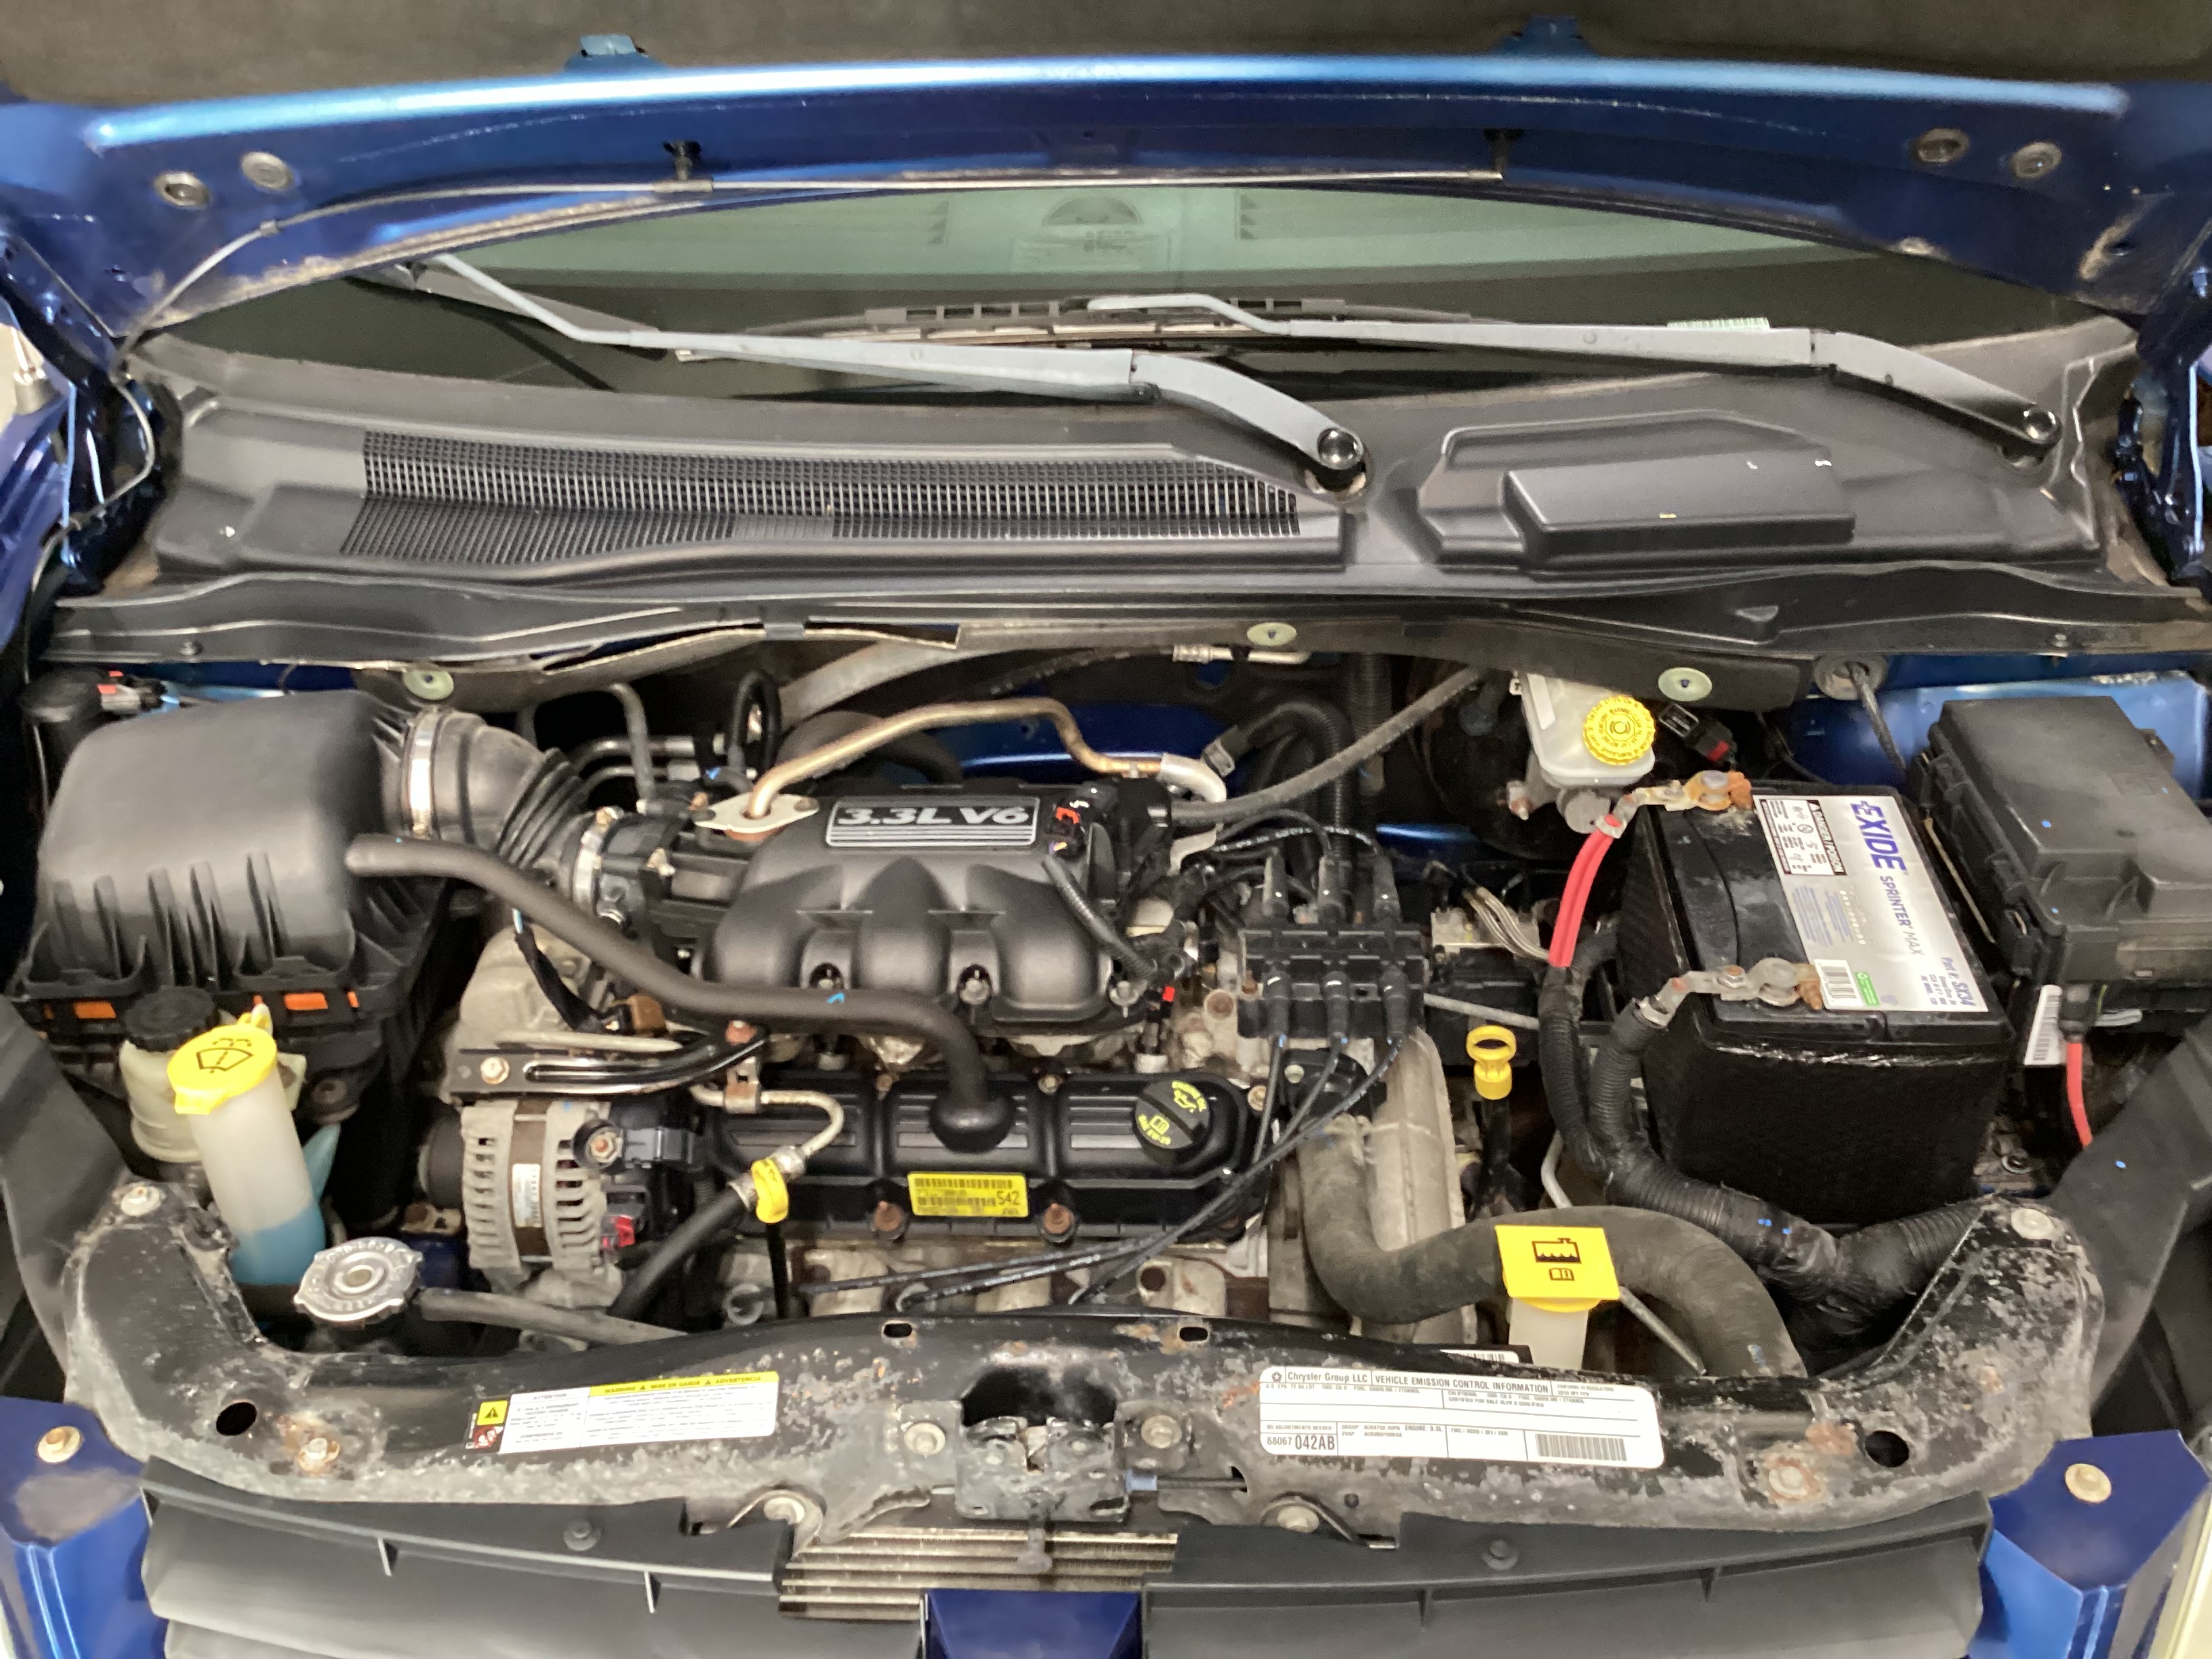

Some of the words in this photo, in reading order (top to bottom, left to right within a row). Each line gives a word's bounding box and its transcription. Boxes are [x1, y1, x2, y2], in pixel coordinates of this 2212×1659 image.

[838, 808, 951, 825] 3.3L
[960, 807, 1030, 825] V6
[1850, 800, 1907, 871] EXIDE
[1880, 876, 1910, 926] SPRINTER
[1903, 931, 1925, 956] MAX
[1952, 981, 1975, 1006] SX34
[996, 1191, 1020, 1206] 542
[1288, 1372, 1322, 1383] Chrysler
[1325, 1372, 1349, 1384] Group
[1353, 1374, 1368, 1382] LLC
[1375, 1375, 1408, 1385] VEHICLE
[1412, 1376, 1450, 1387] EMISSION
[1453, 1379, 1490, 1389] CONTROL
[1493, 1381, 1549, 1393] INFORMATION
[1267, 1436, 1292, 1446] 68067
[1295, 1435, 1335, 1450] 042AB
